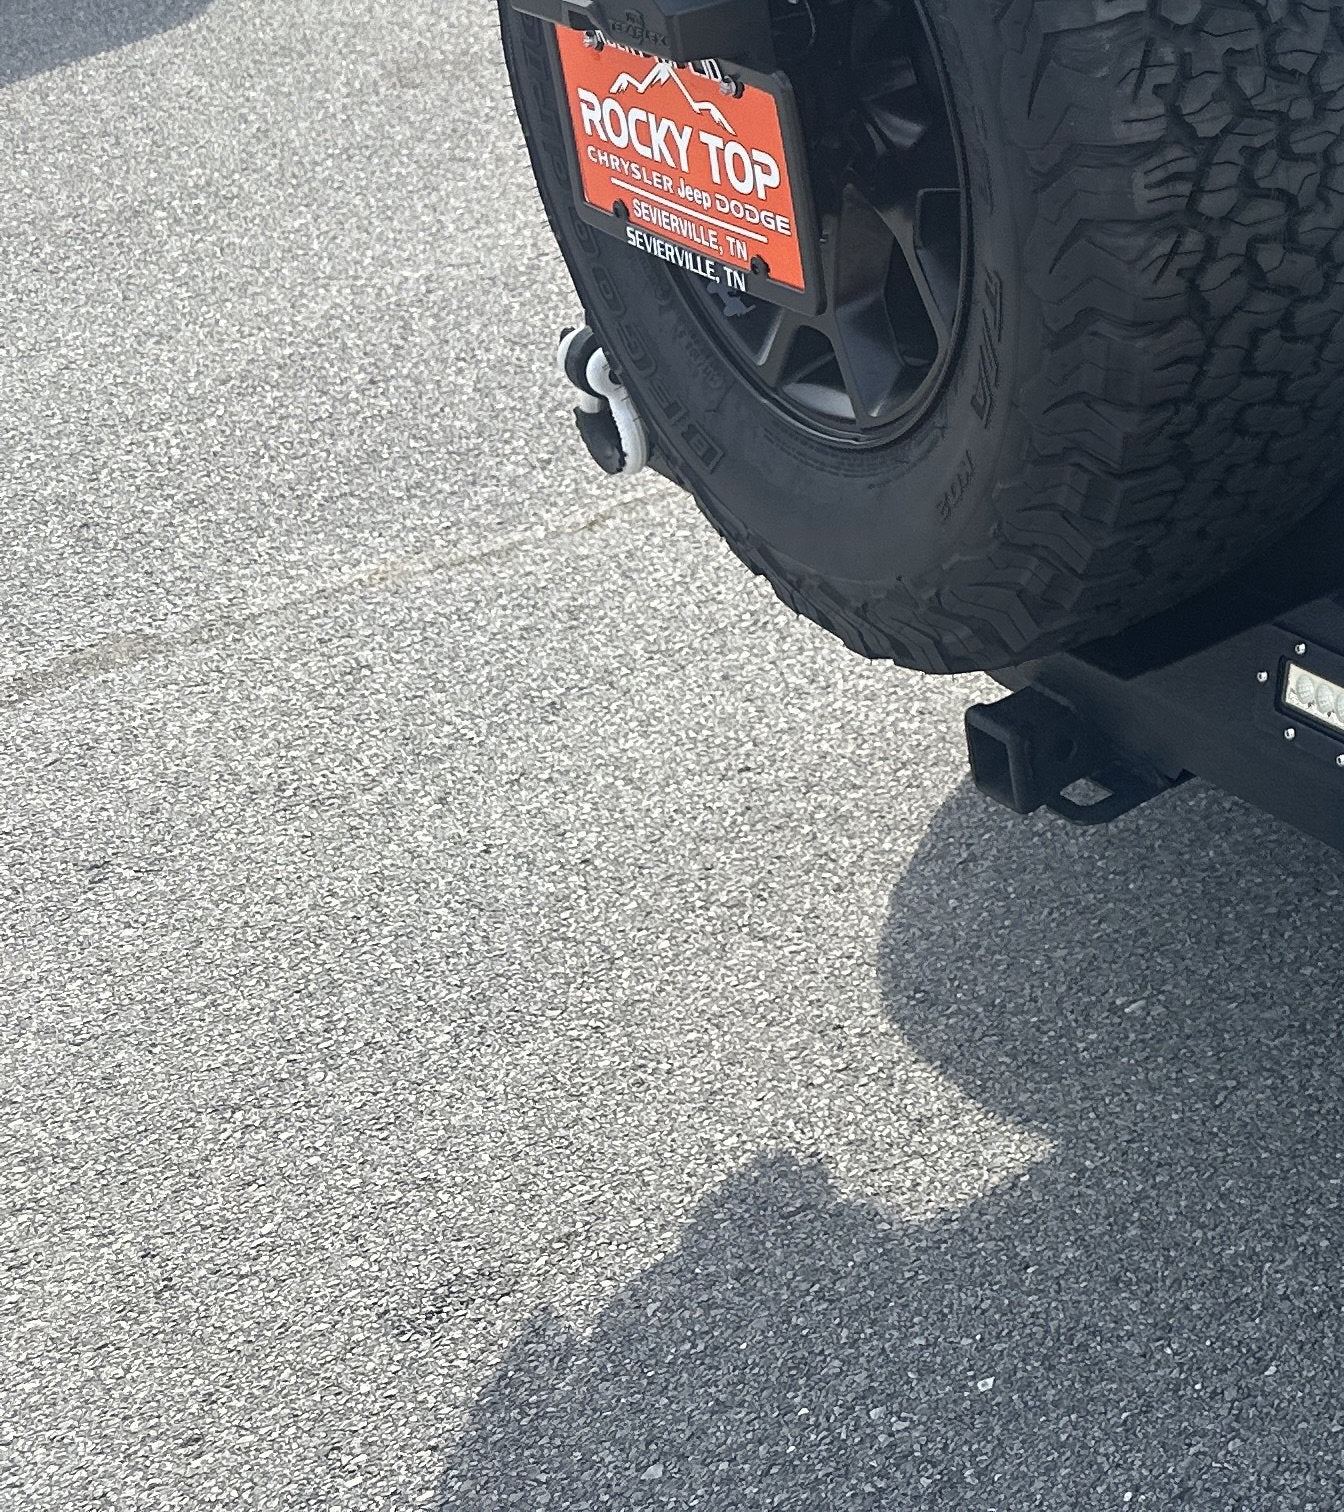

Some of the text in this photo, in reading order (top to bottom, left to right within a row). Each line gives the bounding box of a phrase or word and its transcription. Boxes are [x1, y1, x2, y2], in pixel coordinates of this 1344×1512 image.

[577, 88, 781, 200] ROCKY TOP
[587, 145, 792, 236] CHRYSLER Jeep DODGE
[632, 198, 749, 262] SEVIERVILLE, TN
[626, 225, 746, 292] SEVIERVILLE, TN
